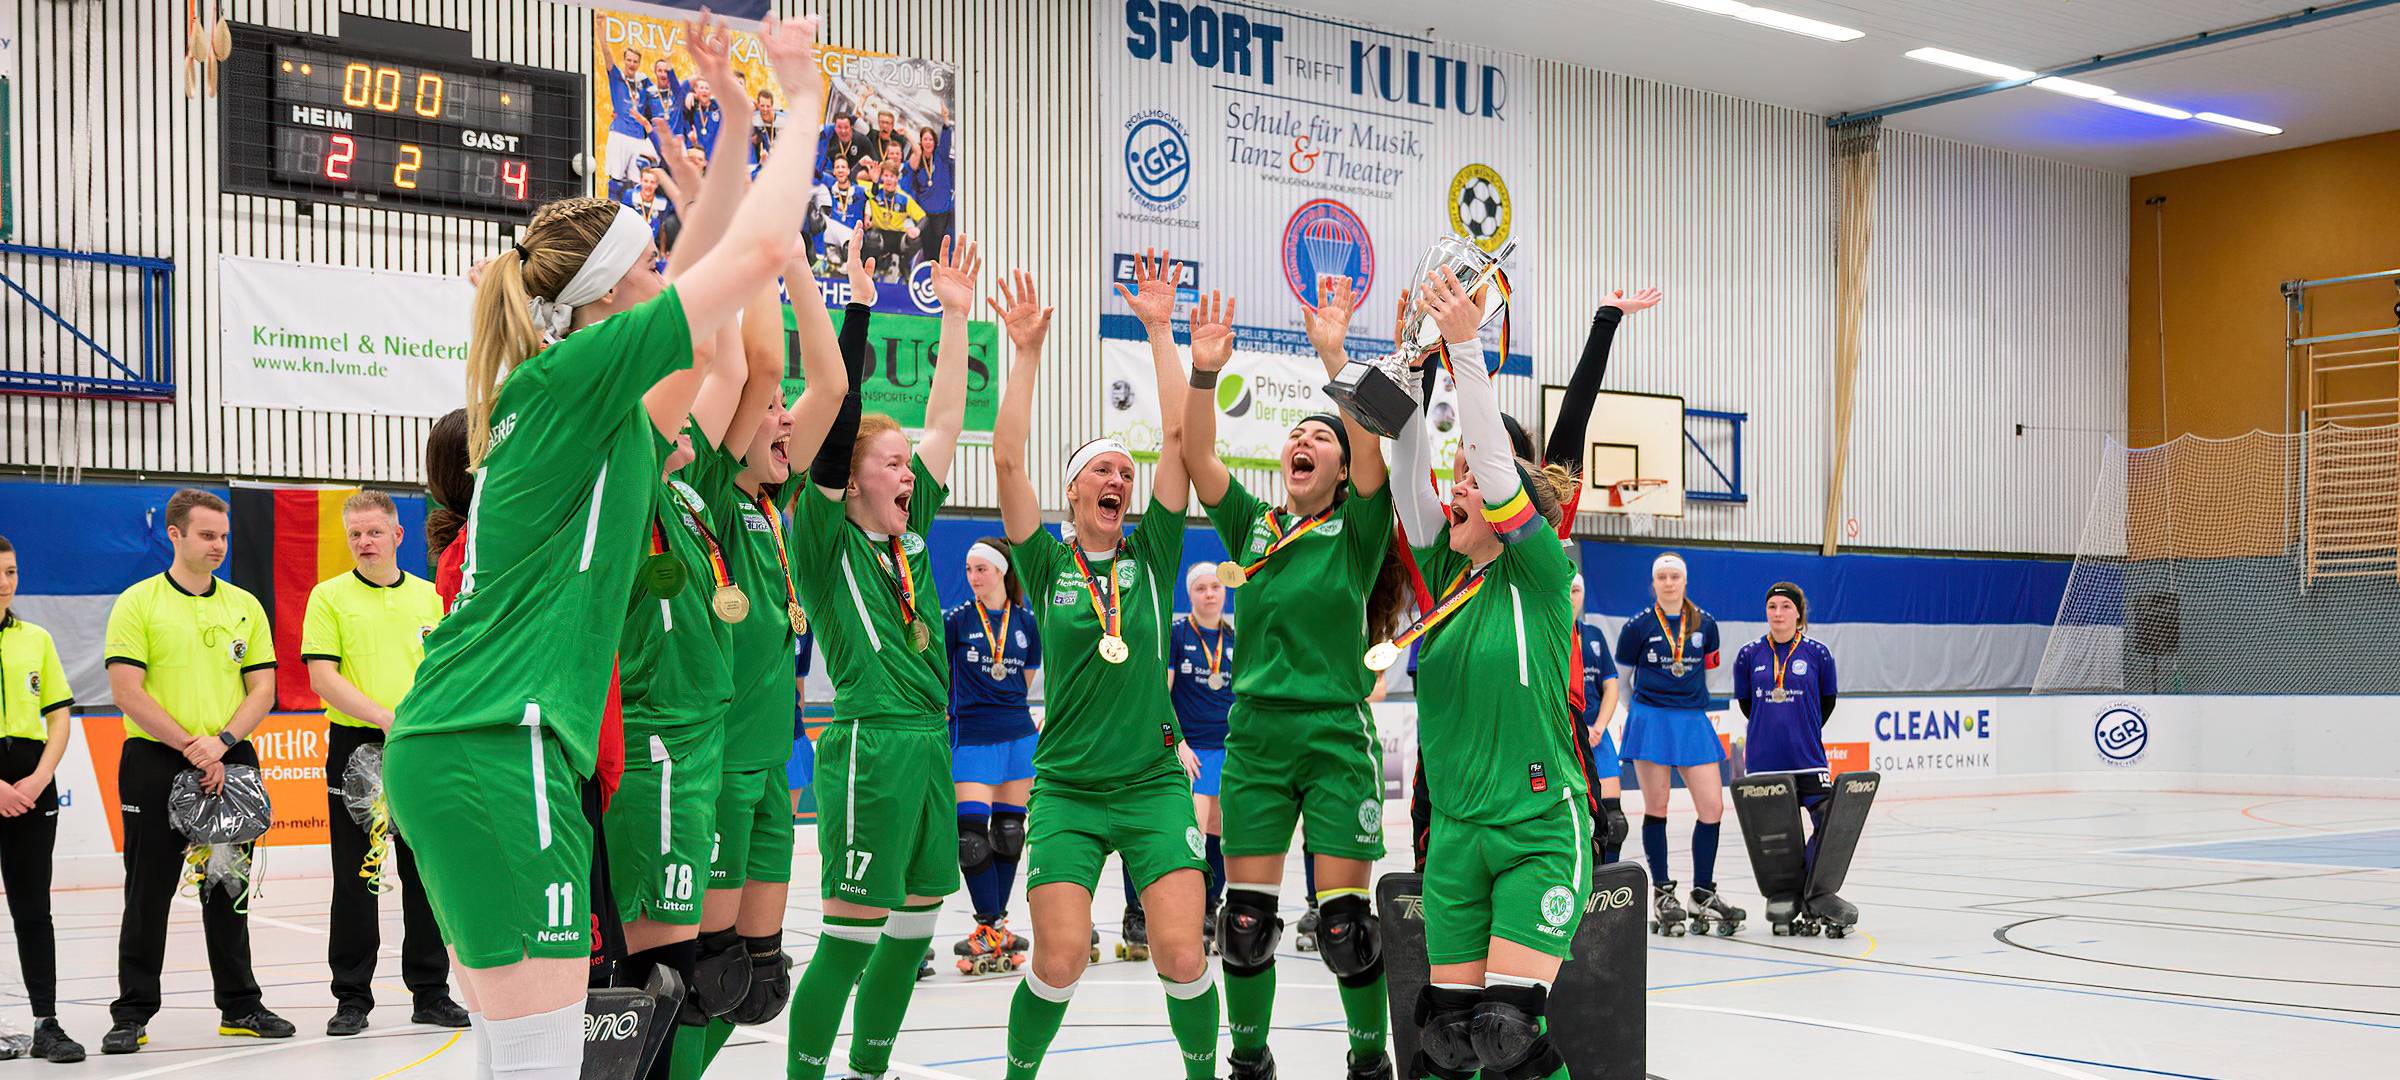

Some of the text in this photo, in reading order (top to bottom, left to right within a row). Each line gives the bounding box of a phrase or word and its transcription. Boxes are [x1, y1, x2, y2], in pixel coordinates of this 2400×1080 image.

[605, 17, 776, 66] DRIV-KAL
[882, 60, 946, 92] 2016
[1126, 0, 1507, 121] SPORT TRIFFT KULTUR
[292, 105, 353, 130] HEIM
[1227, 102, 1424, 162] Schule für Musik,
[461, 130, 519, 152] GAST
[325, 132, 528, 200] 2 2 4
[1227, 136, 1403, 187] Tanz & Theater
[253, 324, 469, 361] Krimmel & Niederd
[252, 355, 389, 378] www.kn.lvm.de
[1255, 376, 1312, 402] Physio
[1255, 401, 1277, 421] Der
[252, 728, 319, 762] MEHR
[261, 765, 328, 780] FÖRDERT
[1874, 753, 1990, 772] SOLARTECHNIK
[845, 850, 873, 881] 17
[664, 863, 693, 900] 18
[840, 882, 868, 896] Dicke
[544, 881, 574, 927] 11
[655, 899, 694, 912] Lütters
[537, 930, 580, 943] Necke
[583, 1010, 640, 1042] eno
